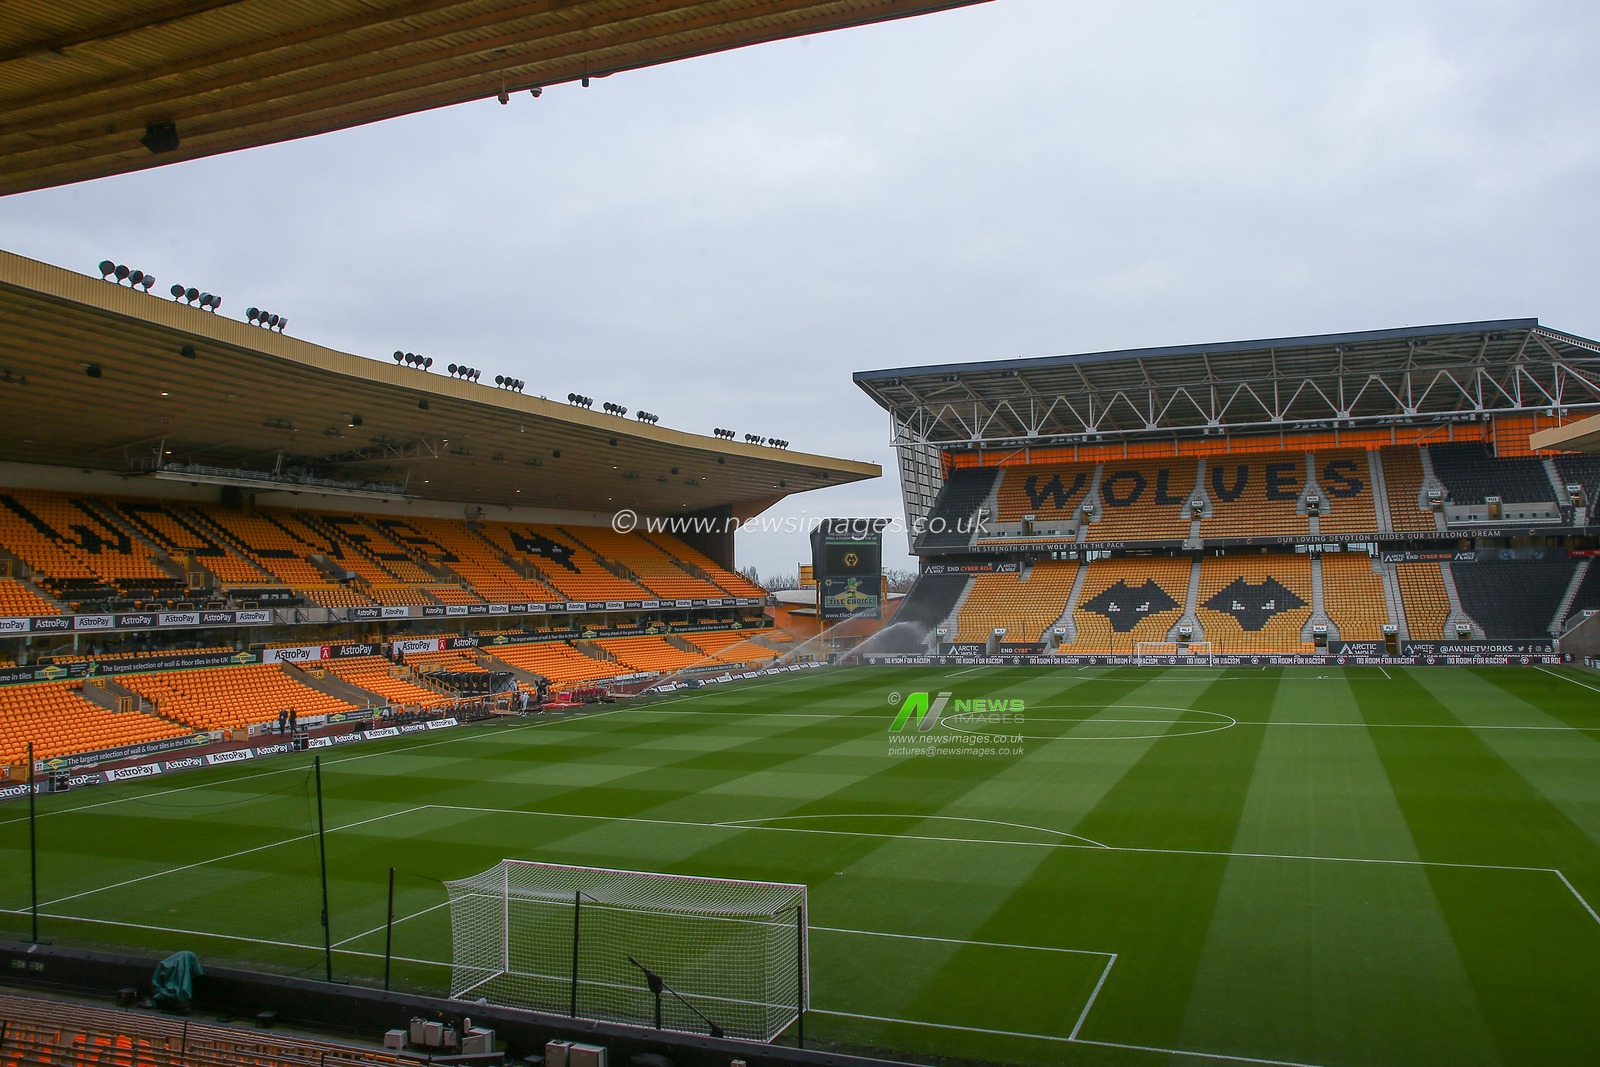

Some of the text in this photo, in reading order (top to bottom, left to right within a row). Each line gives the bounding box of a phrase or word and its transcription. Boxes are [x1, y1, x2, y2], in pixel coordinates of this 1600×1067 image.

[1024, 460, 1366, 510] WOLVES
[121, 616, 151, 625] AstroPay
[165, 614, 195, 623] AstroPay
[204, 614, 232, 622] AstroPay
[240, 612, 266, 621] AstroPay
[0, 621, 24, 630] troPay
[36, 619, 69, 628] AstroPay
[78, 617, 110, 627] AstroPay
[402, 641, 430, 651] AstroPay
[454, 638, 478, 647] AstroPay
[340, 645, 372, 655] AstroPay
[1440, 645, 1513, 654] @AWNETWORKS
[275, 649, 310, 660] AstroPay
[114, 664, 131, 673] largest
[401, 723, 425, 732] AstroPay
[369, 728, 394, 737] AstroPay
[334, 733, 361, 743] AstroPay
[256, 744, 288, 756] AstroPay
[80, 754, 98, 764] largest
[100, 751, 124, 760] selection
[213, 751, 247, 762] AstroPay
[165, 757, 202, 770] AstroPay
[114, 765, 154, 779] AstroPay
